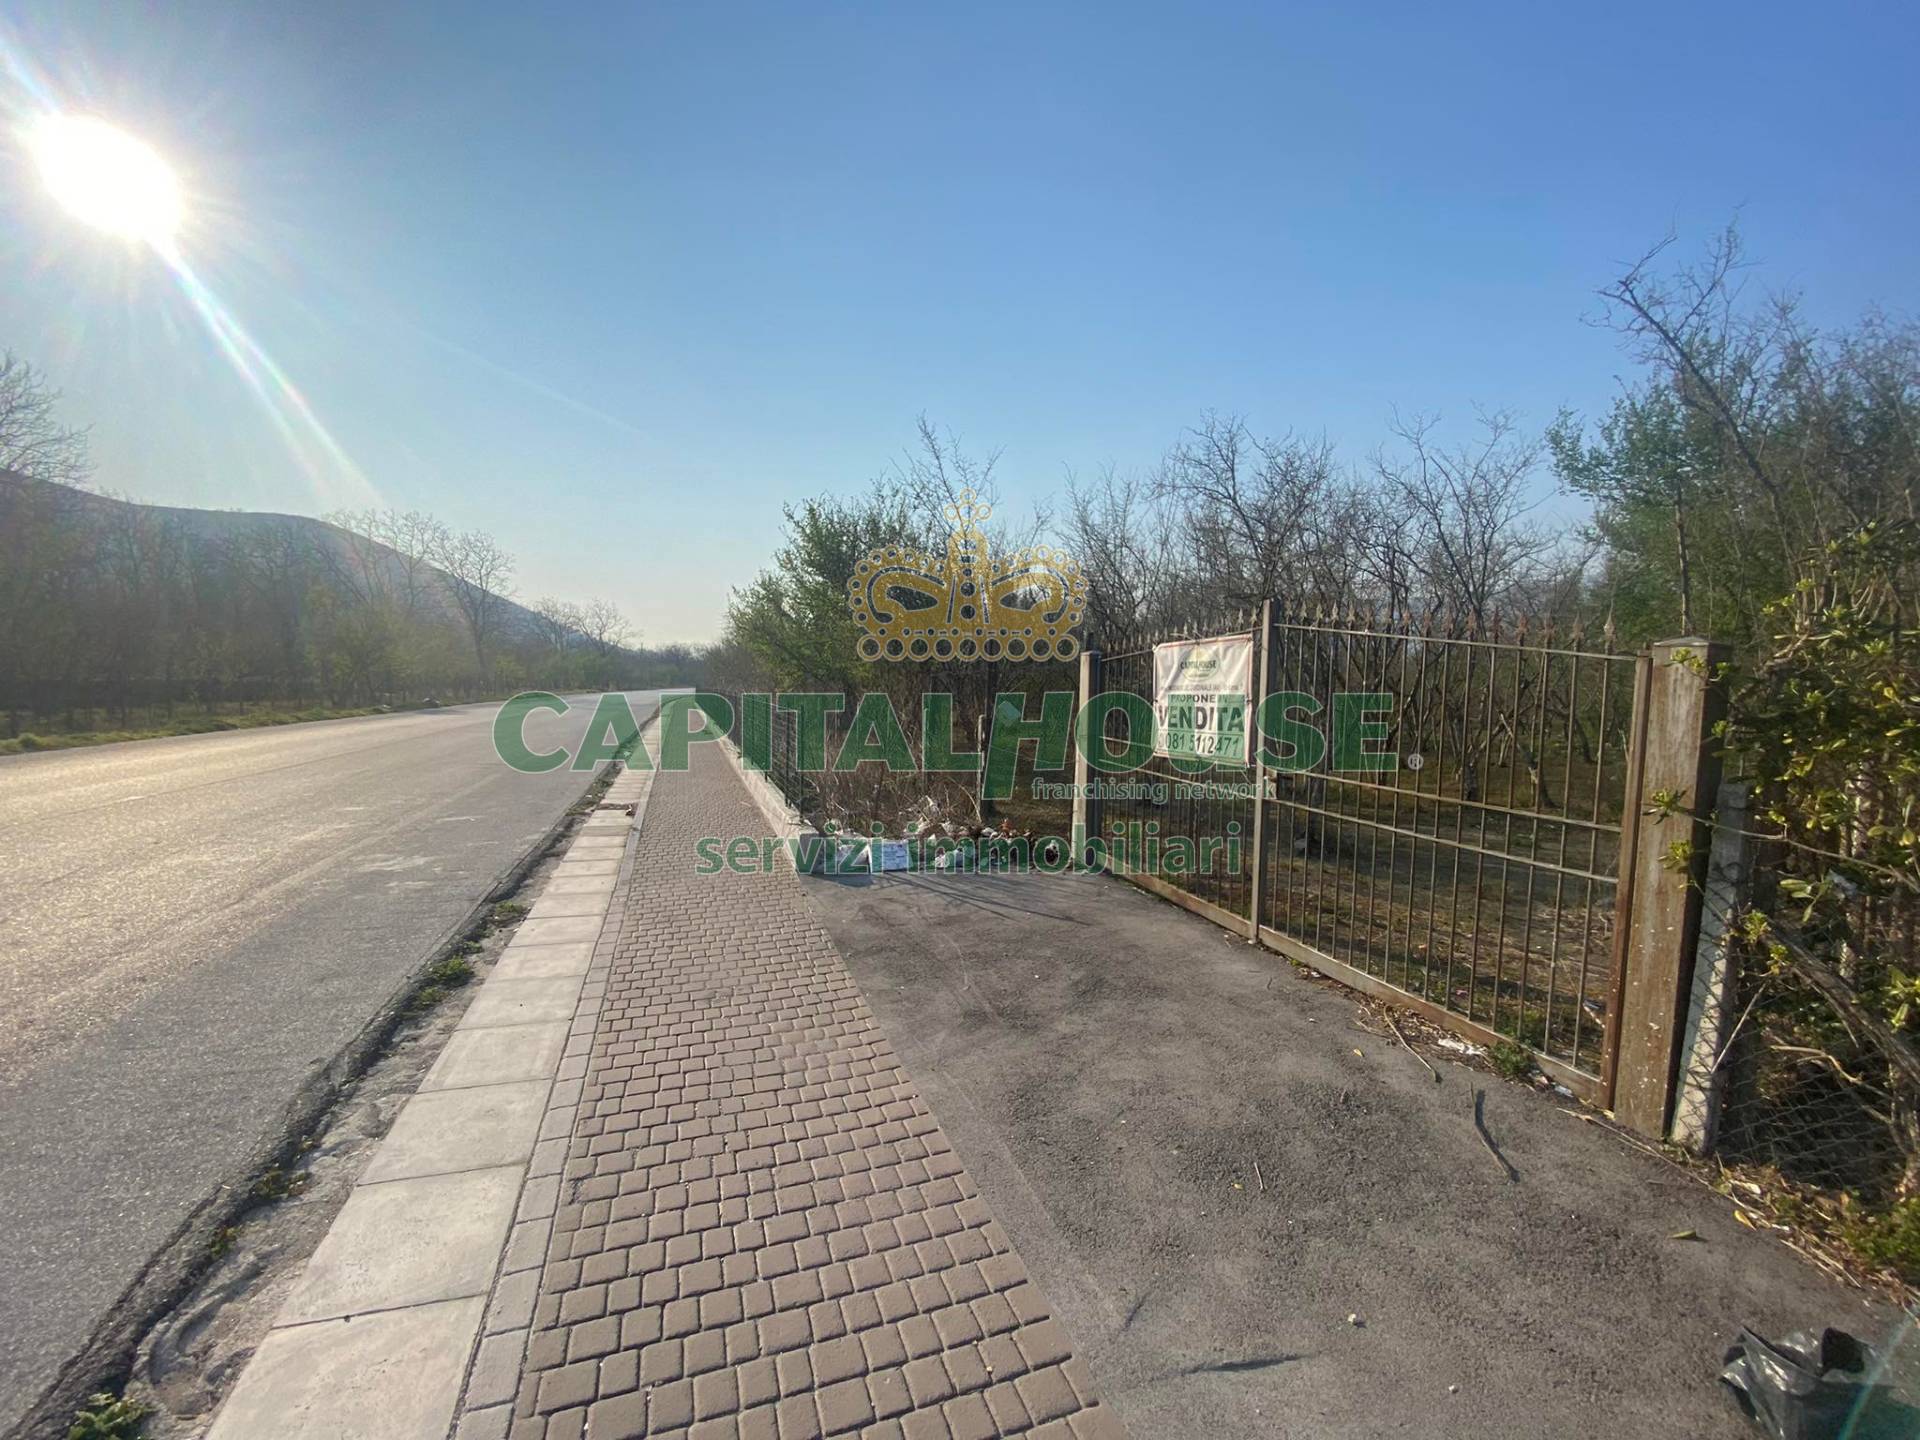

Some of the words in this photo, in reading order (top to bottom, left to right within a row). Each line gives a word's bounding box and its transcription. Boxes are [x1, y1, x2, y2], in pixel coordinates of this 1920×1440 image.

[1170, 694, 1216, 704] PROPONE
[1158, 705, 1245, 732] VENDITA
[1166, 732, 1185, 750] 081
[1188, 733, 1239, 757] 5112471
